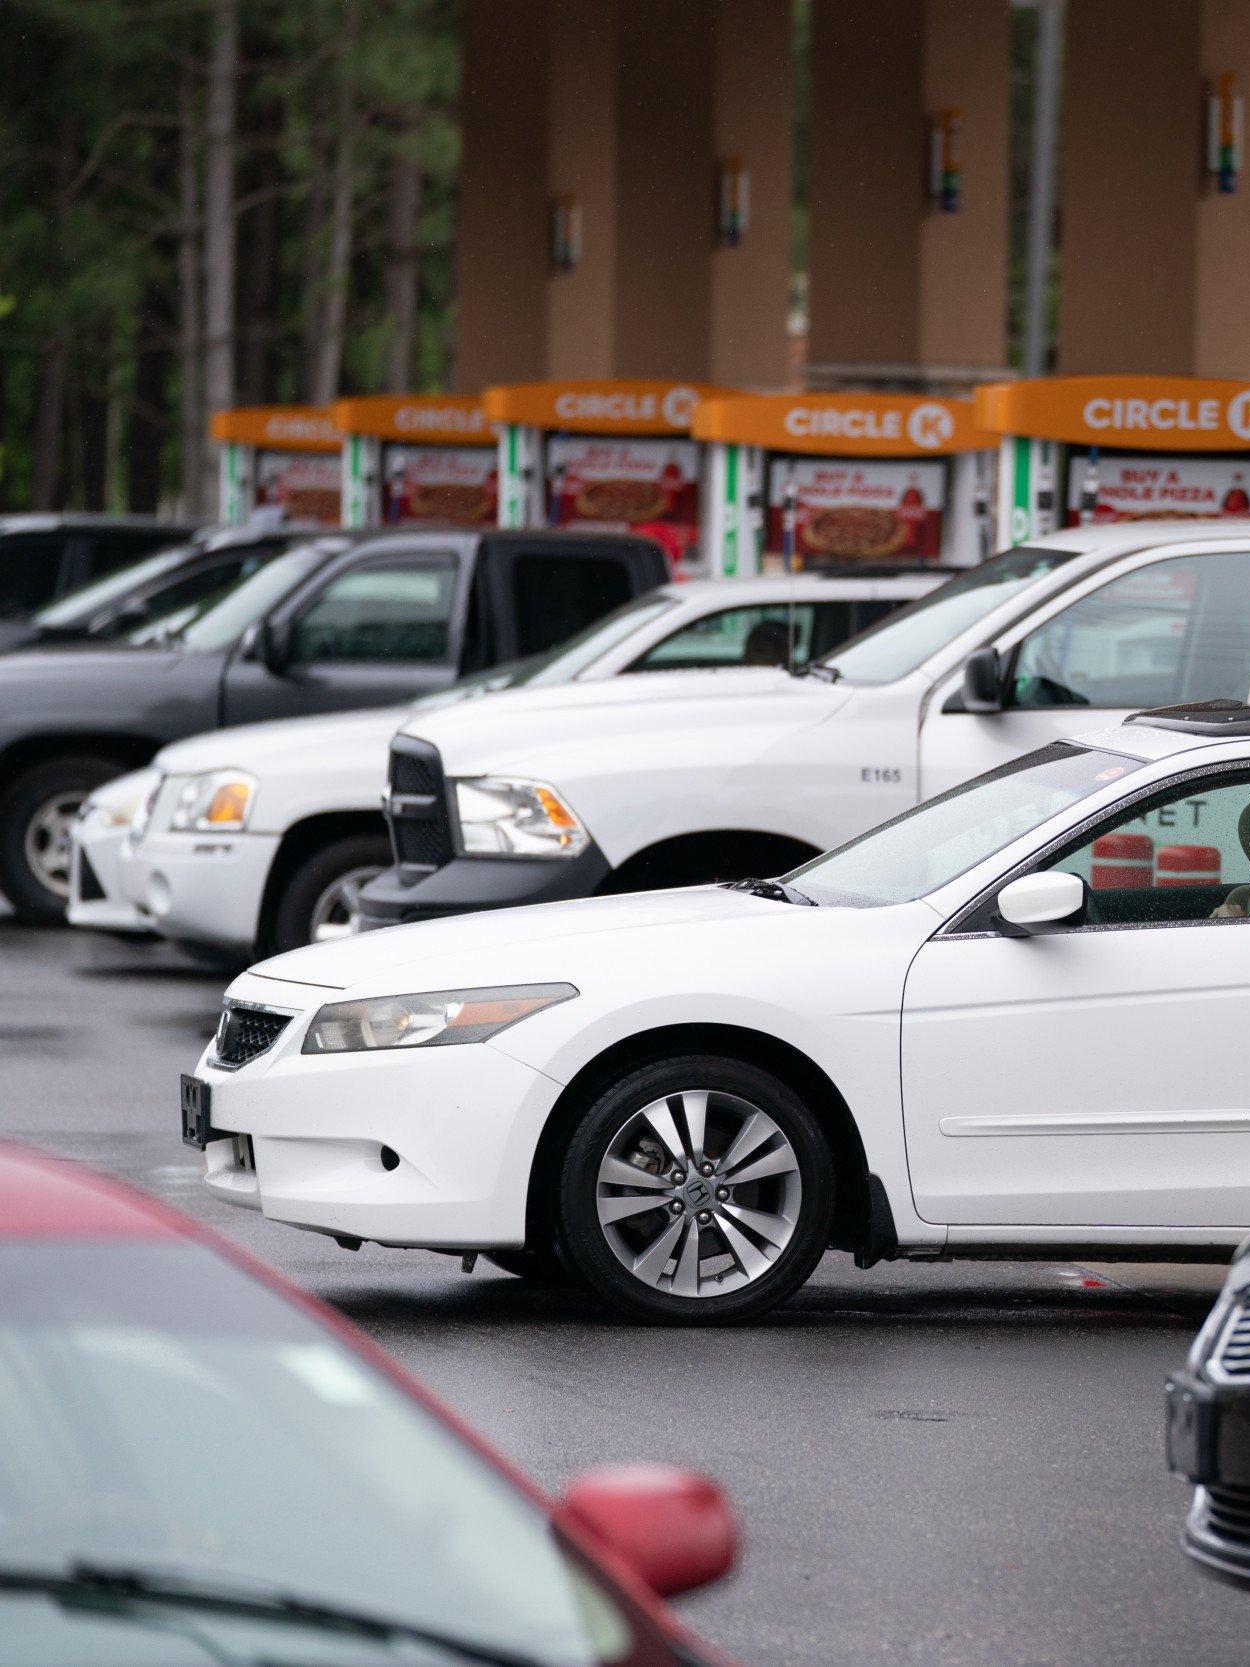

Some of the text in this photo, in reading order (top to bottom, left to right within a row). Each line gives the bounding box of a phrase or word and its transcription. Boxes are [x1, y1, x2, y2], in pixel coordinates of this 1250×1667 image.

[556, 393, 658, 420] CIRCLE
[1083, 398, 1220, 431] CIRCLE
[785, 407, 901, 439] CIRCLE
[861, 767, 902, 784] E165
[1137, 800, 1207, 827] ET
